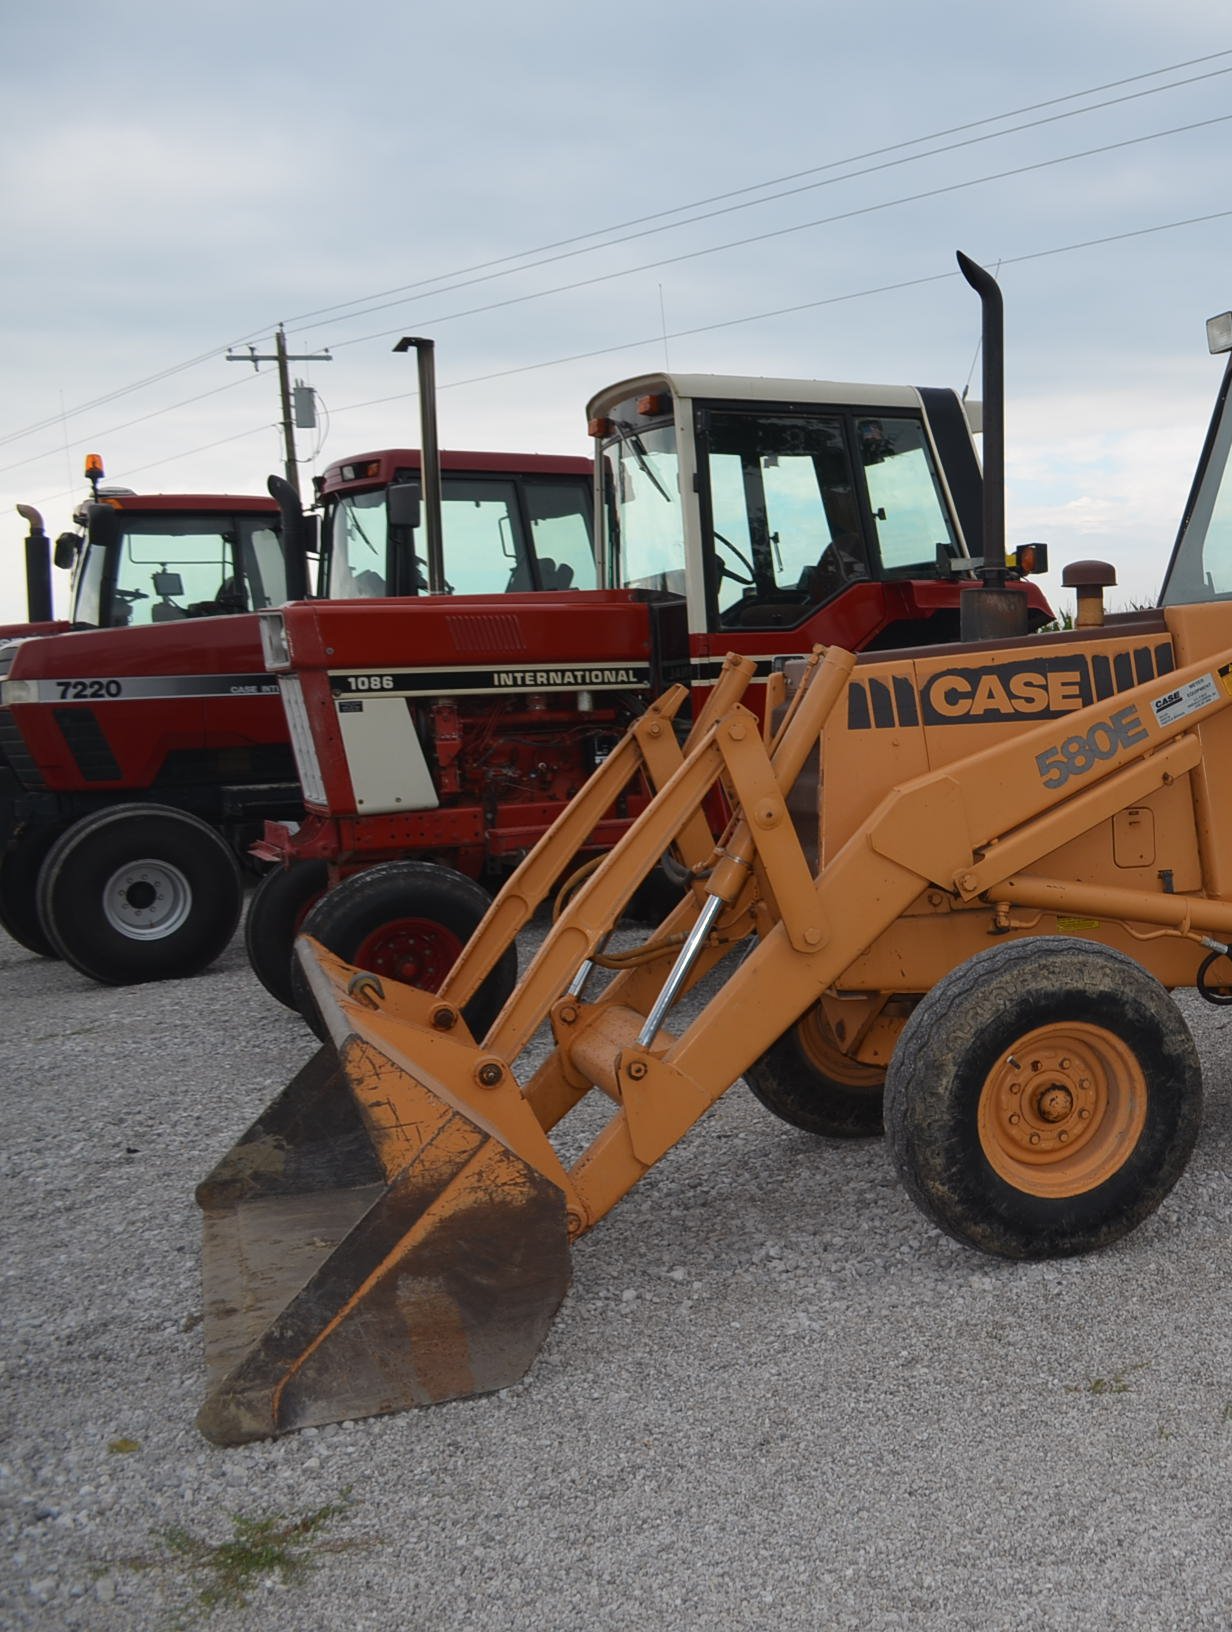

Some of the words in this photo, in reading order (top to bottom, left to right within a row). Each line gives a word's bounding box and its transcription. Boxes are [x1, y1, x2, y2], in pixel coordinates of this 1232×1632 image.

[347, 676, 394, 690] 1086
[493, 669, 638, 686] INTERNATIONAL
[56, 679, 122, 699] 7220
[930, 671, 1083, 717] CASE
[1155, 690, 1181, 709] CASE
[1035, 704, 1149, 789] 580E
